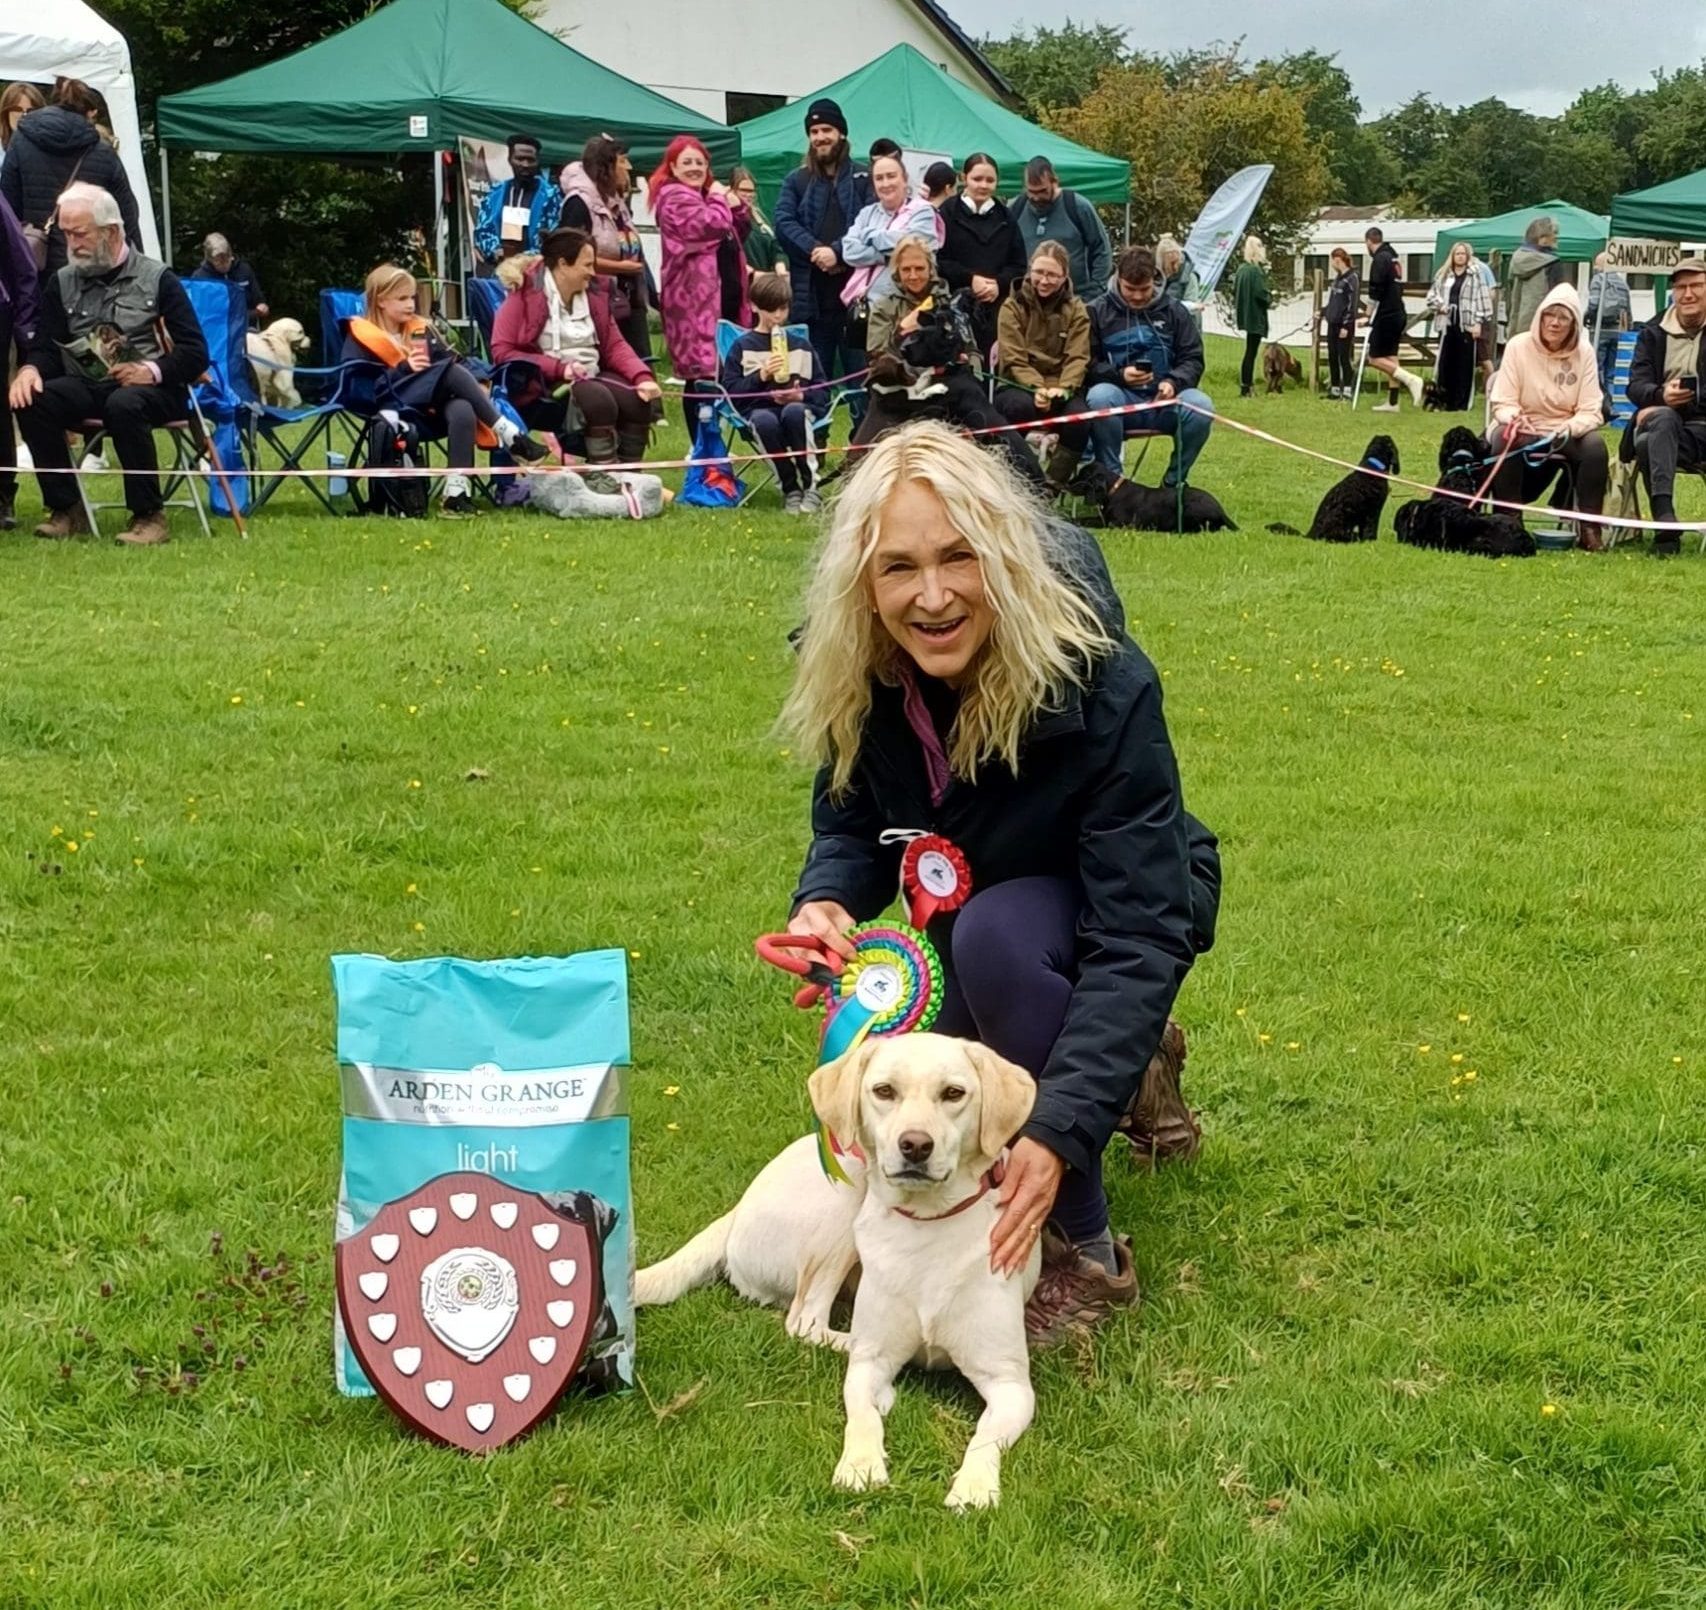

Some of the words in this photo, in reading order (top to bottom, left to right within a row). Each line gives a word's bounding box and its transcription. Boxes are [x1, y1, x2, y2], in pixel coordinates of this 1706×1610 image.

[1606, 242, 1679, 268] SANDWICHES
[388, 1079, 473, 1101] ARDEN
[480, 1079, 585, 1102] GRANGE
[457, 1141, 519, 1172] light
